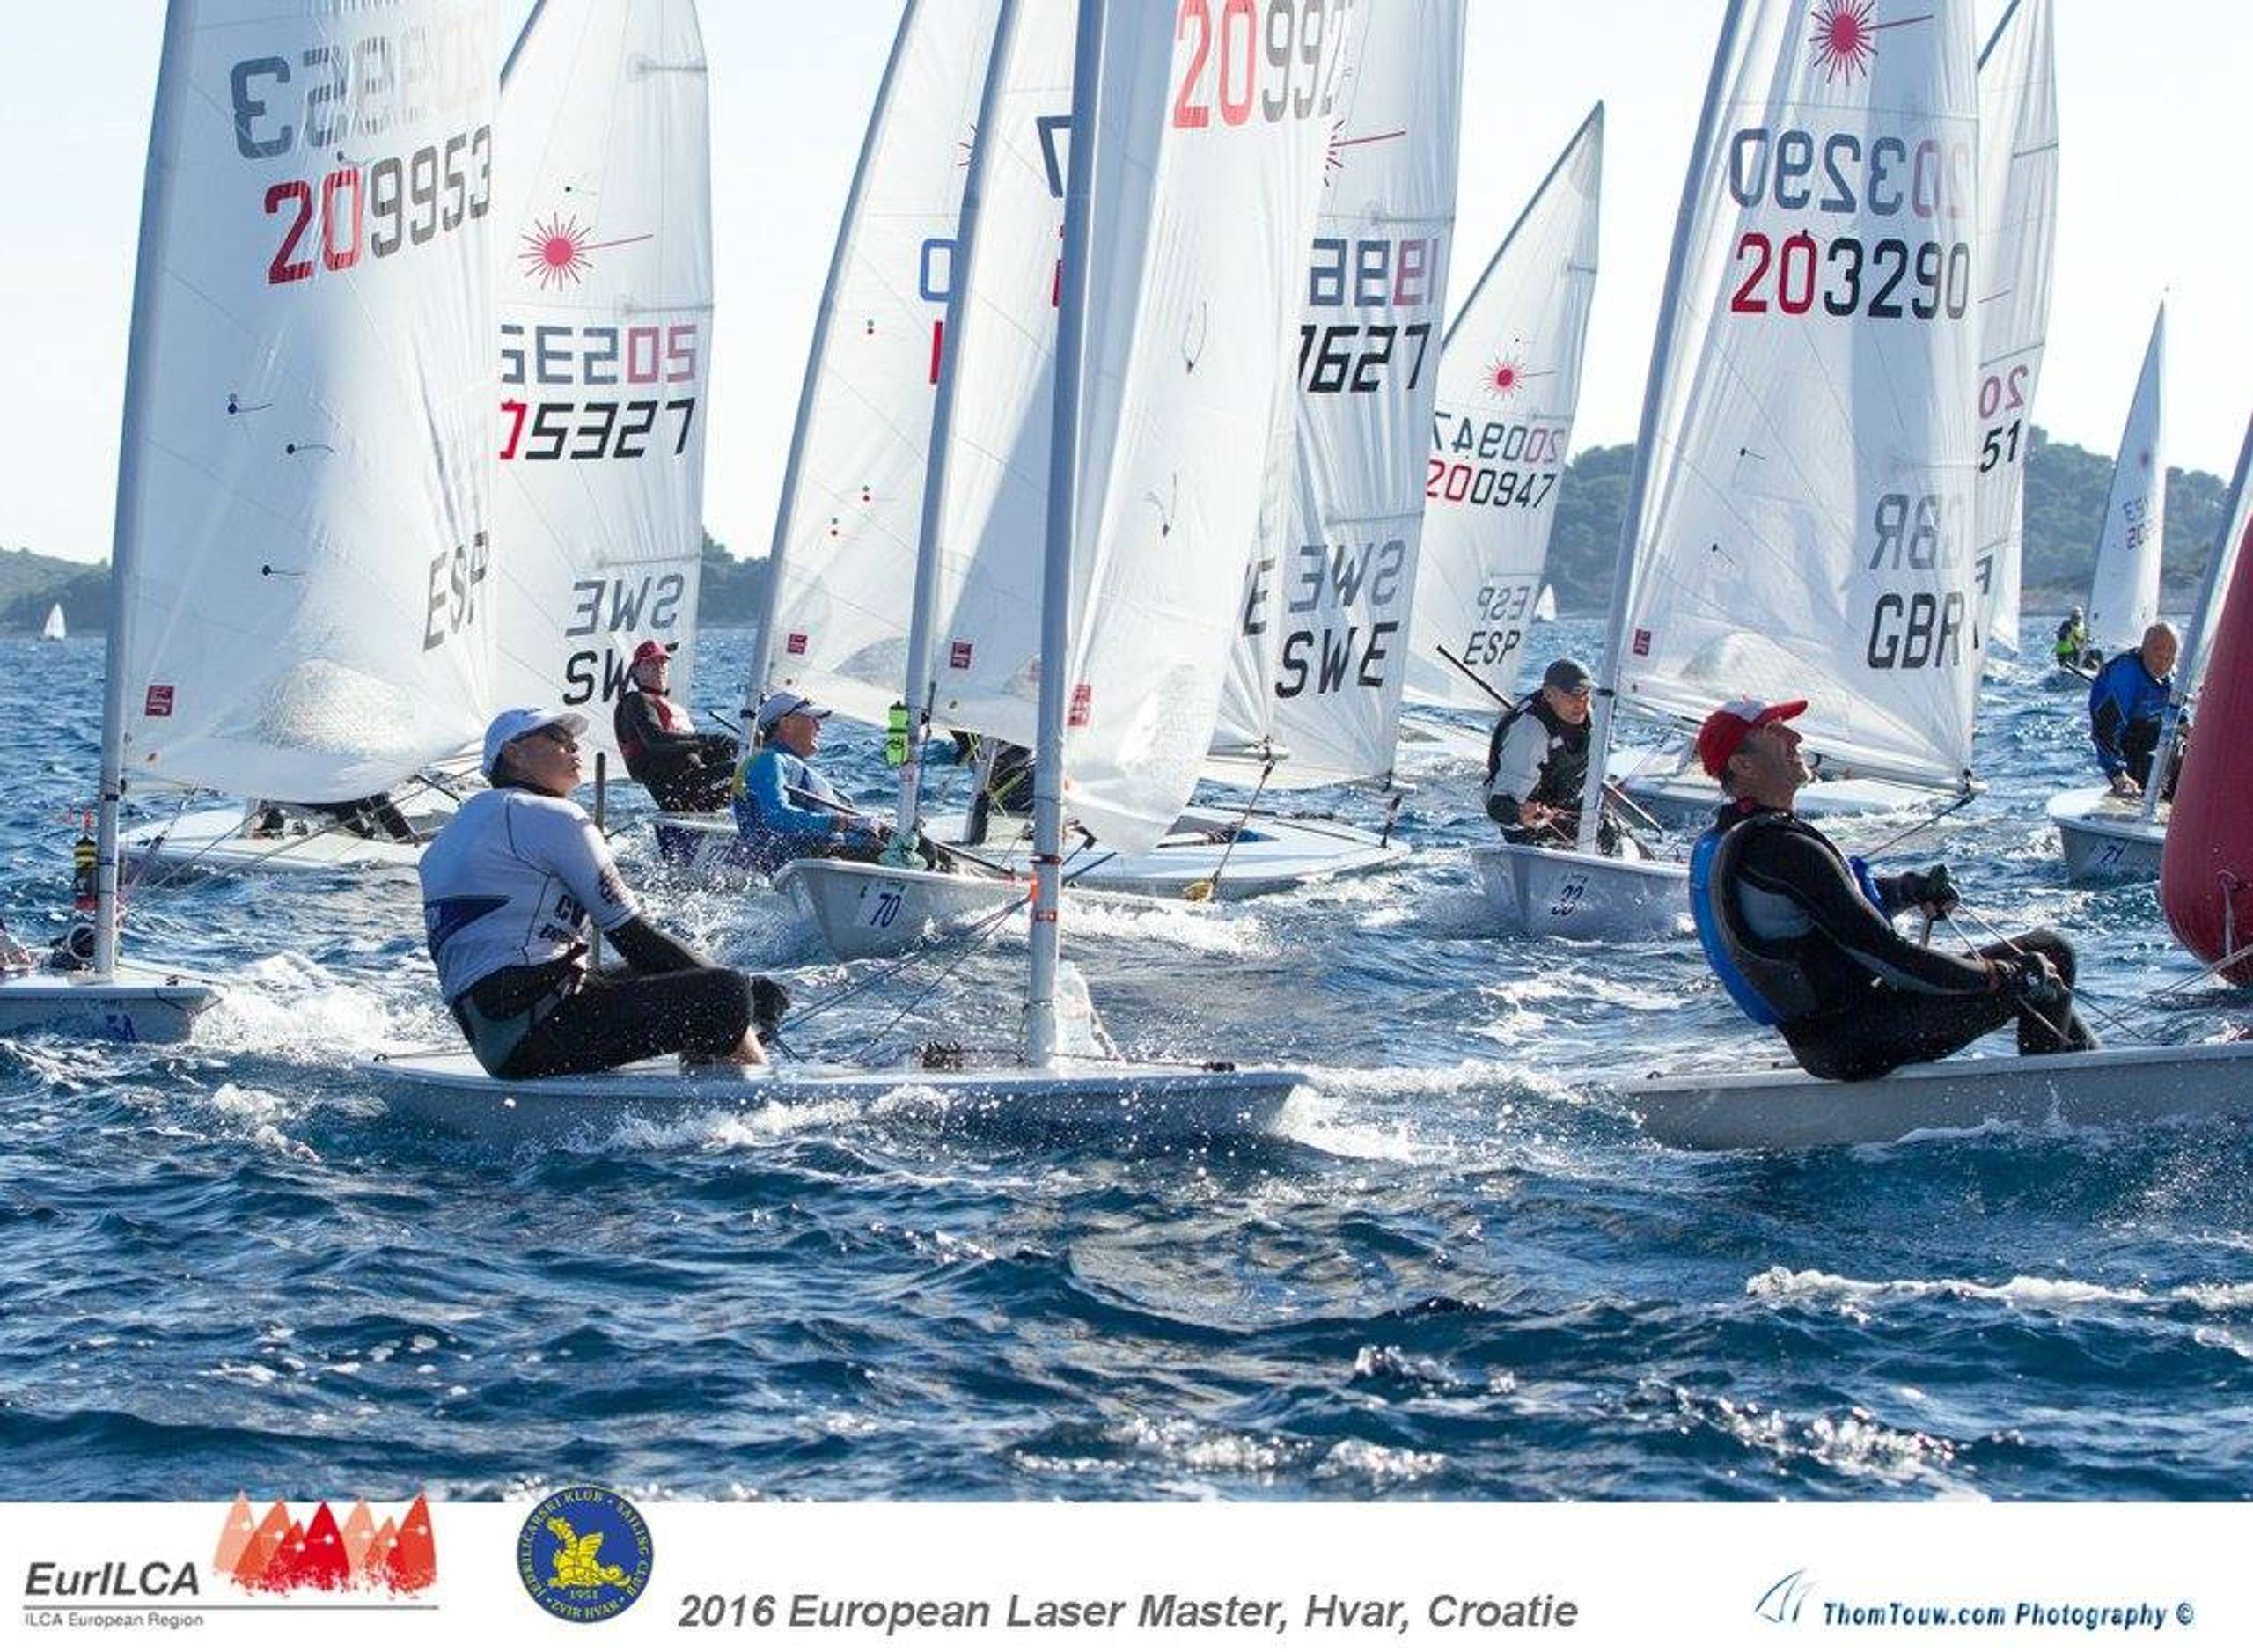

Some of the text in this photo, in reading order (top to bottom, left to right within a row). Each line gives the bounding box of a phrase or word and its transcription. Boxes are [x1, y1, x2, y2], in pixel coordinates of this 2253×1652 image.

[264, 124, 491, 284] 209953
[1731, 233, 1970, 319] 203290
[1426, 459, 1554, 509] 200947
[422, 530, 489, 651] ESP
[1275, 621, 1399, 698] SWE
[1464, 630, 1521, 665] ESP
[1868, 592, 1964, 668] GBR
[562, 642, 679, 705] SW
[870, 893, 901, 927] 70
